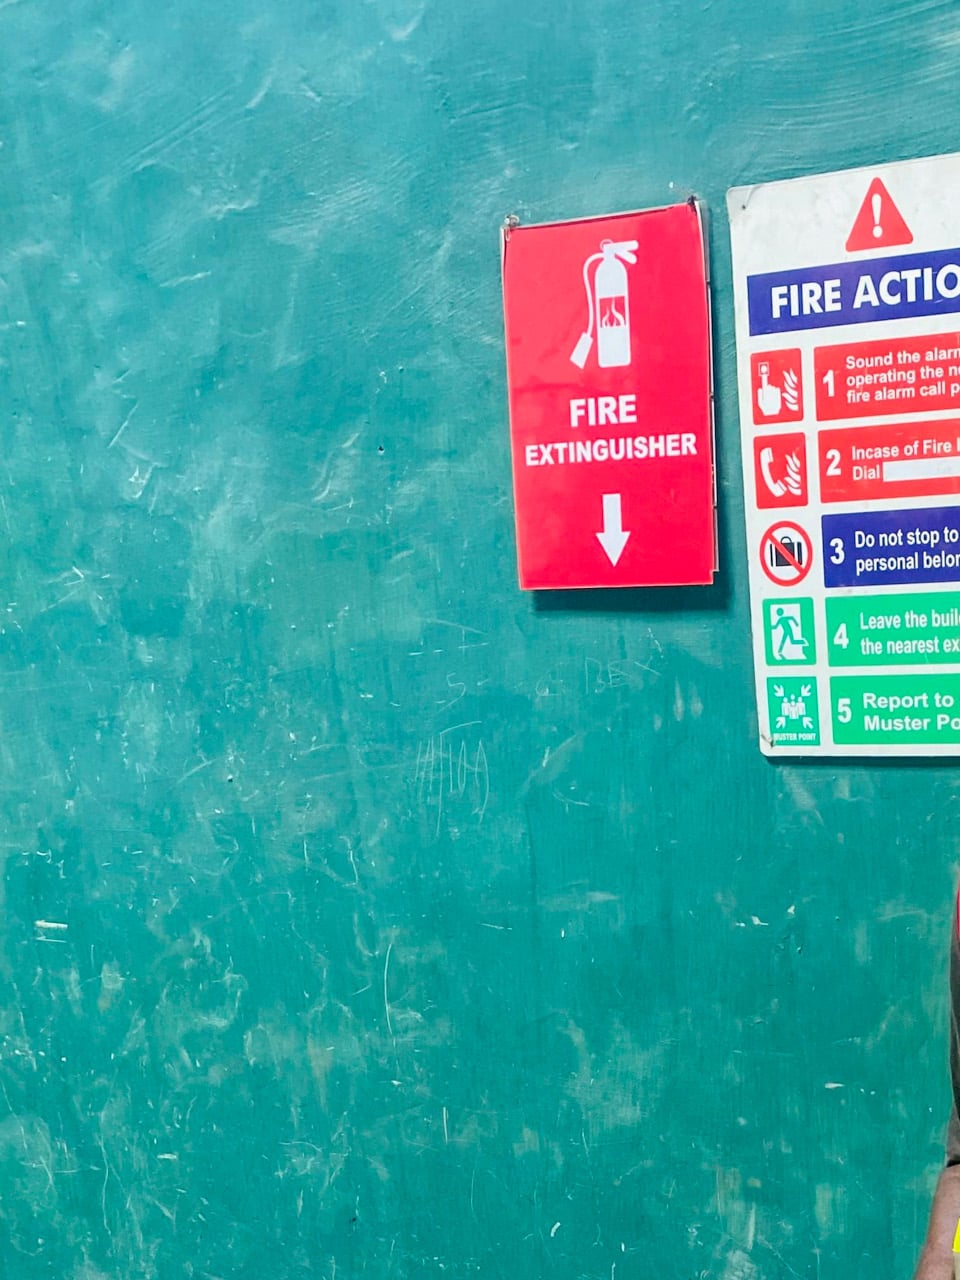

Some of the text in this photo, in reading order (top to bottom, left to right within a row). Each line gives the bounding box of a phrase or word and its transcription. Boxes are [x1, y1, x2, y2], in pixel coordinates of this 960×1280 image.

[771, 279, 841, 318] FIRE
[846, 352, 893, 369] Sound
[897, 350, 920, 364] the
[822, 369, 835, 397] 1
[846, 368, 915, 388] operating
[920, 365, 943, 379] the
[846, 389, 870, 403] fire
[874, 386, 914, 401] alarm
[919, 381, 945, 397] call
[570, 394, 637, 427] FIRE
[525, 433, 697, 466] EXTINGUISHER
[852, 446, 900, 461] Incase
[904, 440, 920, 456] of
[923, 439, 952, 454] Fire
[826, 449, 842, 476] 2
[852, 465, 880, 481] Dial
[855, 530, 875, 548] Do
[879, 529, 903, 546] not
[907, 528, 940, 548] stop
[944, 526, 959, 543] to
[829, 537, 845, 565] 3
[856, 552, 918, 576] personal
[860, 612, 901, 630] Leave
[905, 610, 928, 628] the
[833, 623, 849, 649] 4
[861, 637, 882, 655] the
[887, 636, 939, 654] nearest
[837, 698, 852, 723] 5
[863, 693, 929, 712] Report
[934, 692, 954, 708] to
[864, 714, 930, 731] Muster
